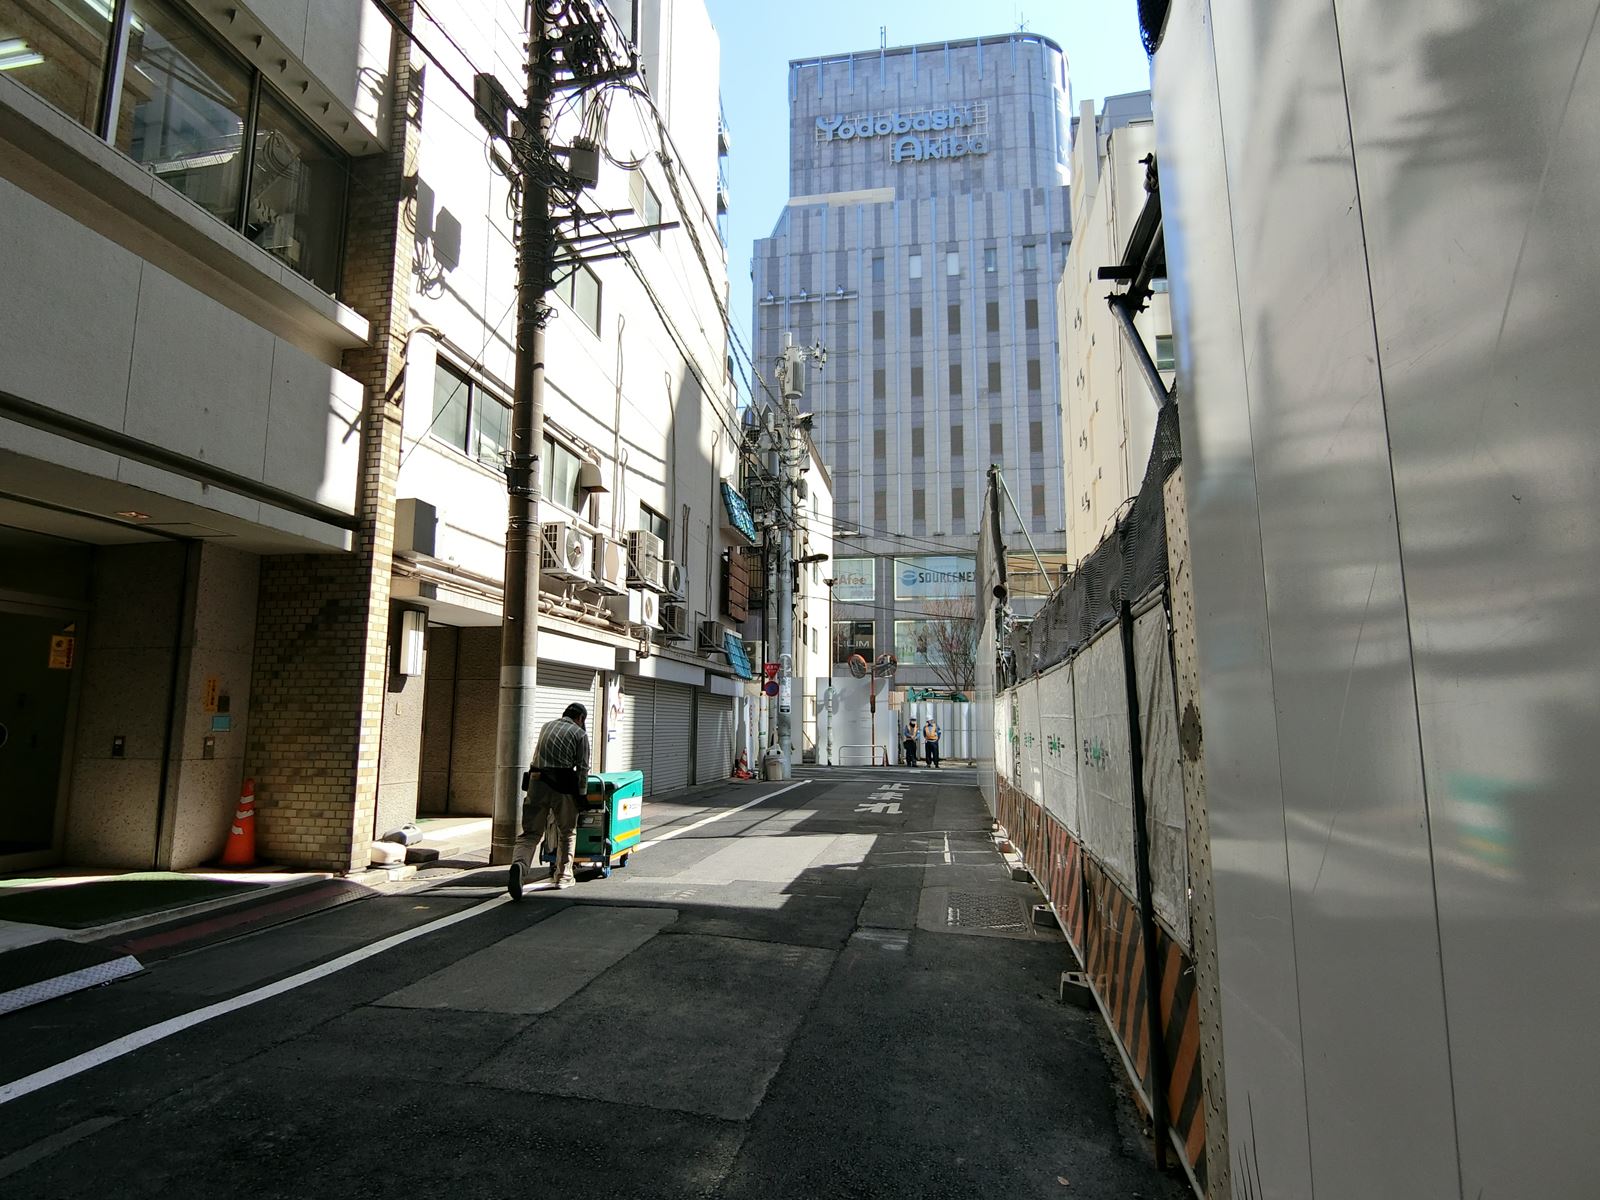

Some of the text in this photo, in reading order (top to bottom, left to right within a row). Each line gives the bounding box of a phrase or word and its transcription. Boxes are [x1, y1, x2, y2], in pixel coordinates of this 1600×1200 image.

[815, 106, 973, 141] Yodobashi
[894, 135, 988, 162] Akiba
[854, 783, 911, 814] 止まれ
